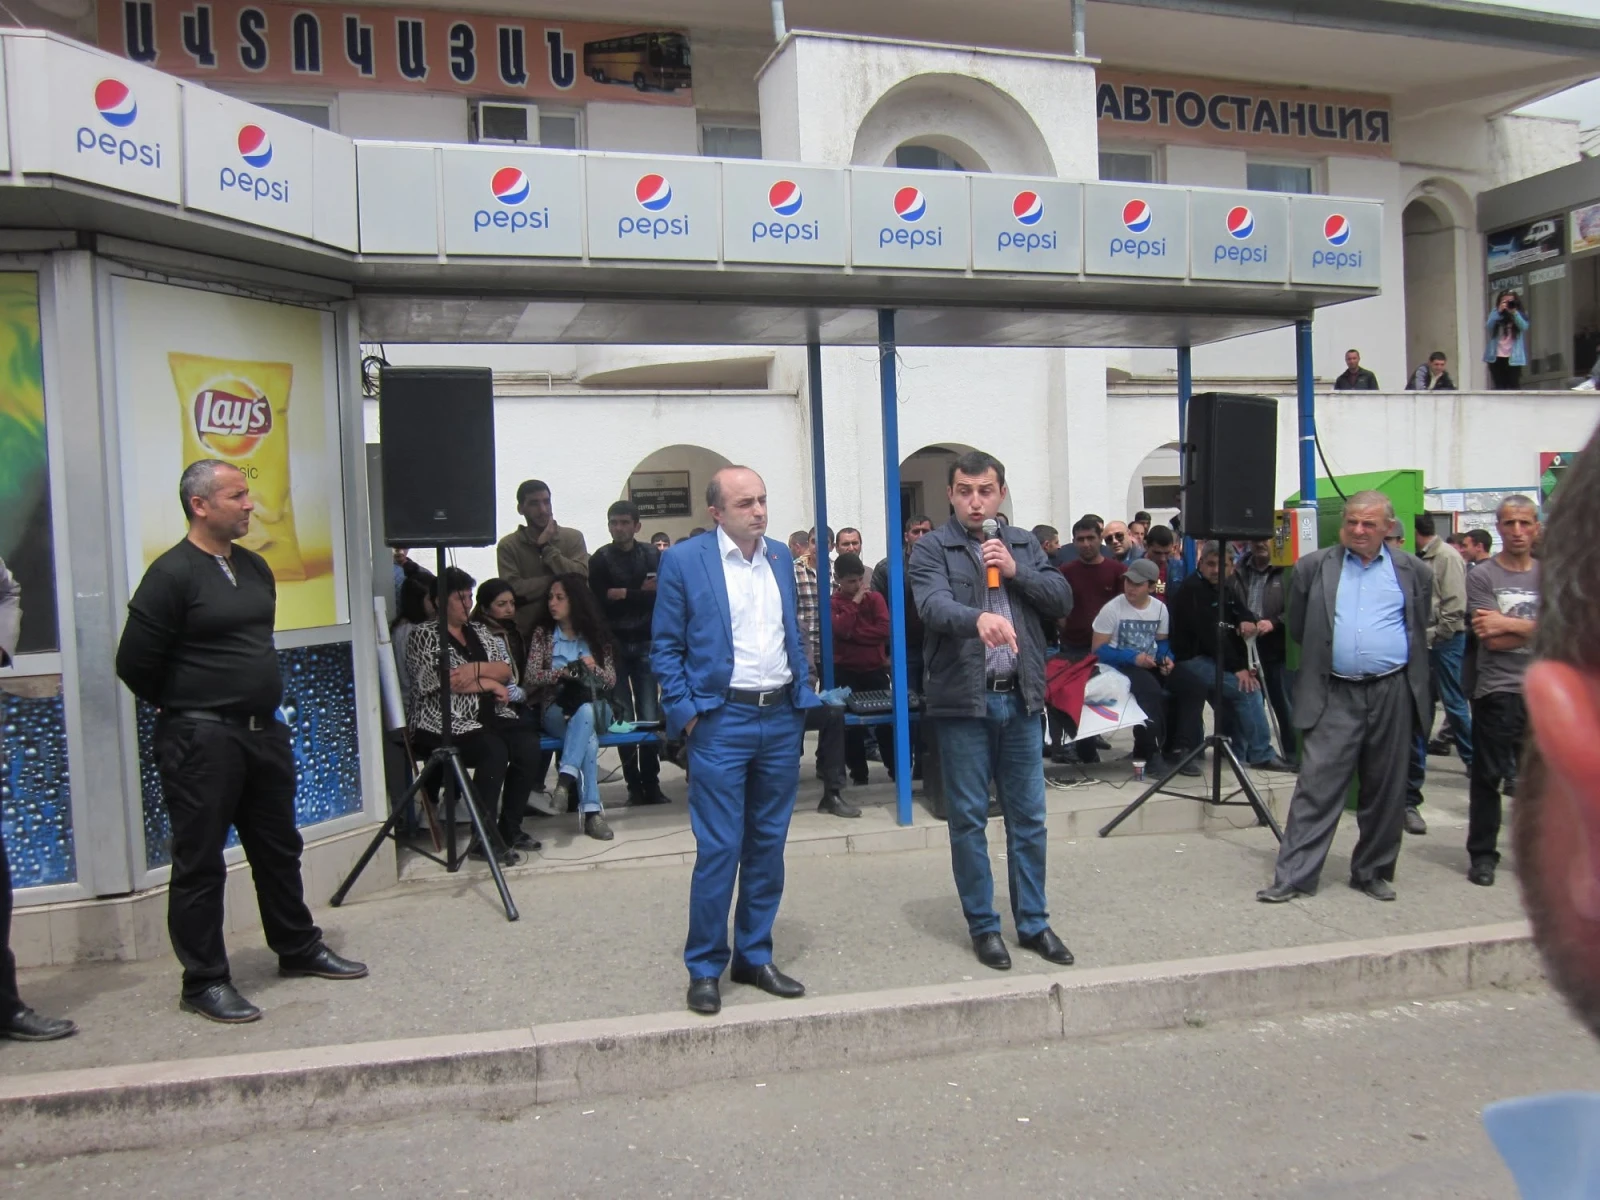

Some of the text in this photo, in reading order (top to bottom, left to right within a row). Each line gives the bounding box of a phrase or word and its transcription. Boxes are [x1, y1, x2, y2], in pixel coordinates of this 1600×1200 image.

[1096, 83, 1391, 144] АВТОСТАНЦИЯ
[76, 127, 161, 169] pepsi
[219, 167, 289, 203] pepsi
[473, 207, 549, 233] pepsi
[618, 215, 689, 239] pepsi
[752, 221, 819, 244] pepsi
[879, 226, 943, 248] pepsi
[997, 231, 1057, 252] pepsi
[1109, 238, 1166, 257] pepsi
[1214, 245, 1268, 263] pepsi
[1312, 250, 1363, 268] pepsi
[200, 391, 267, 435] Lay's
